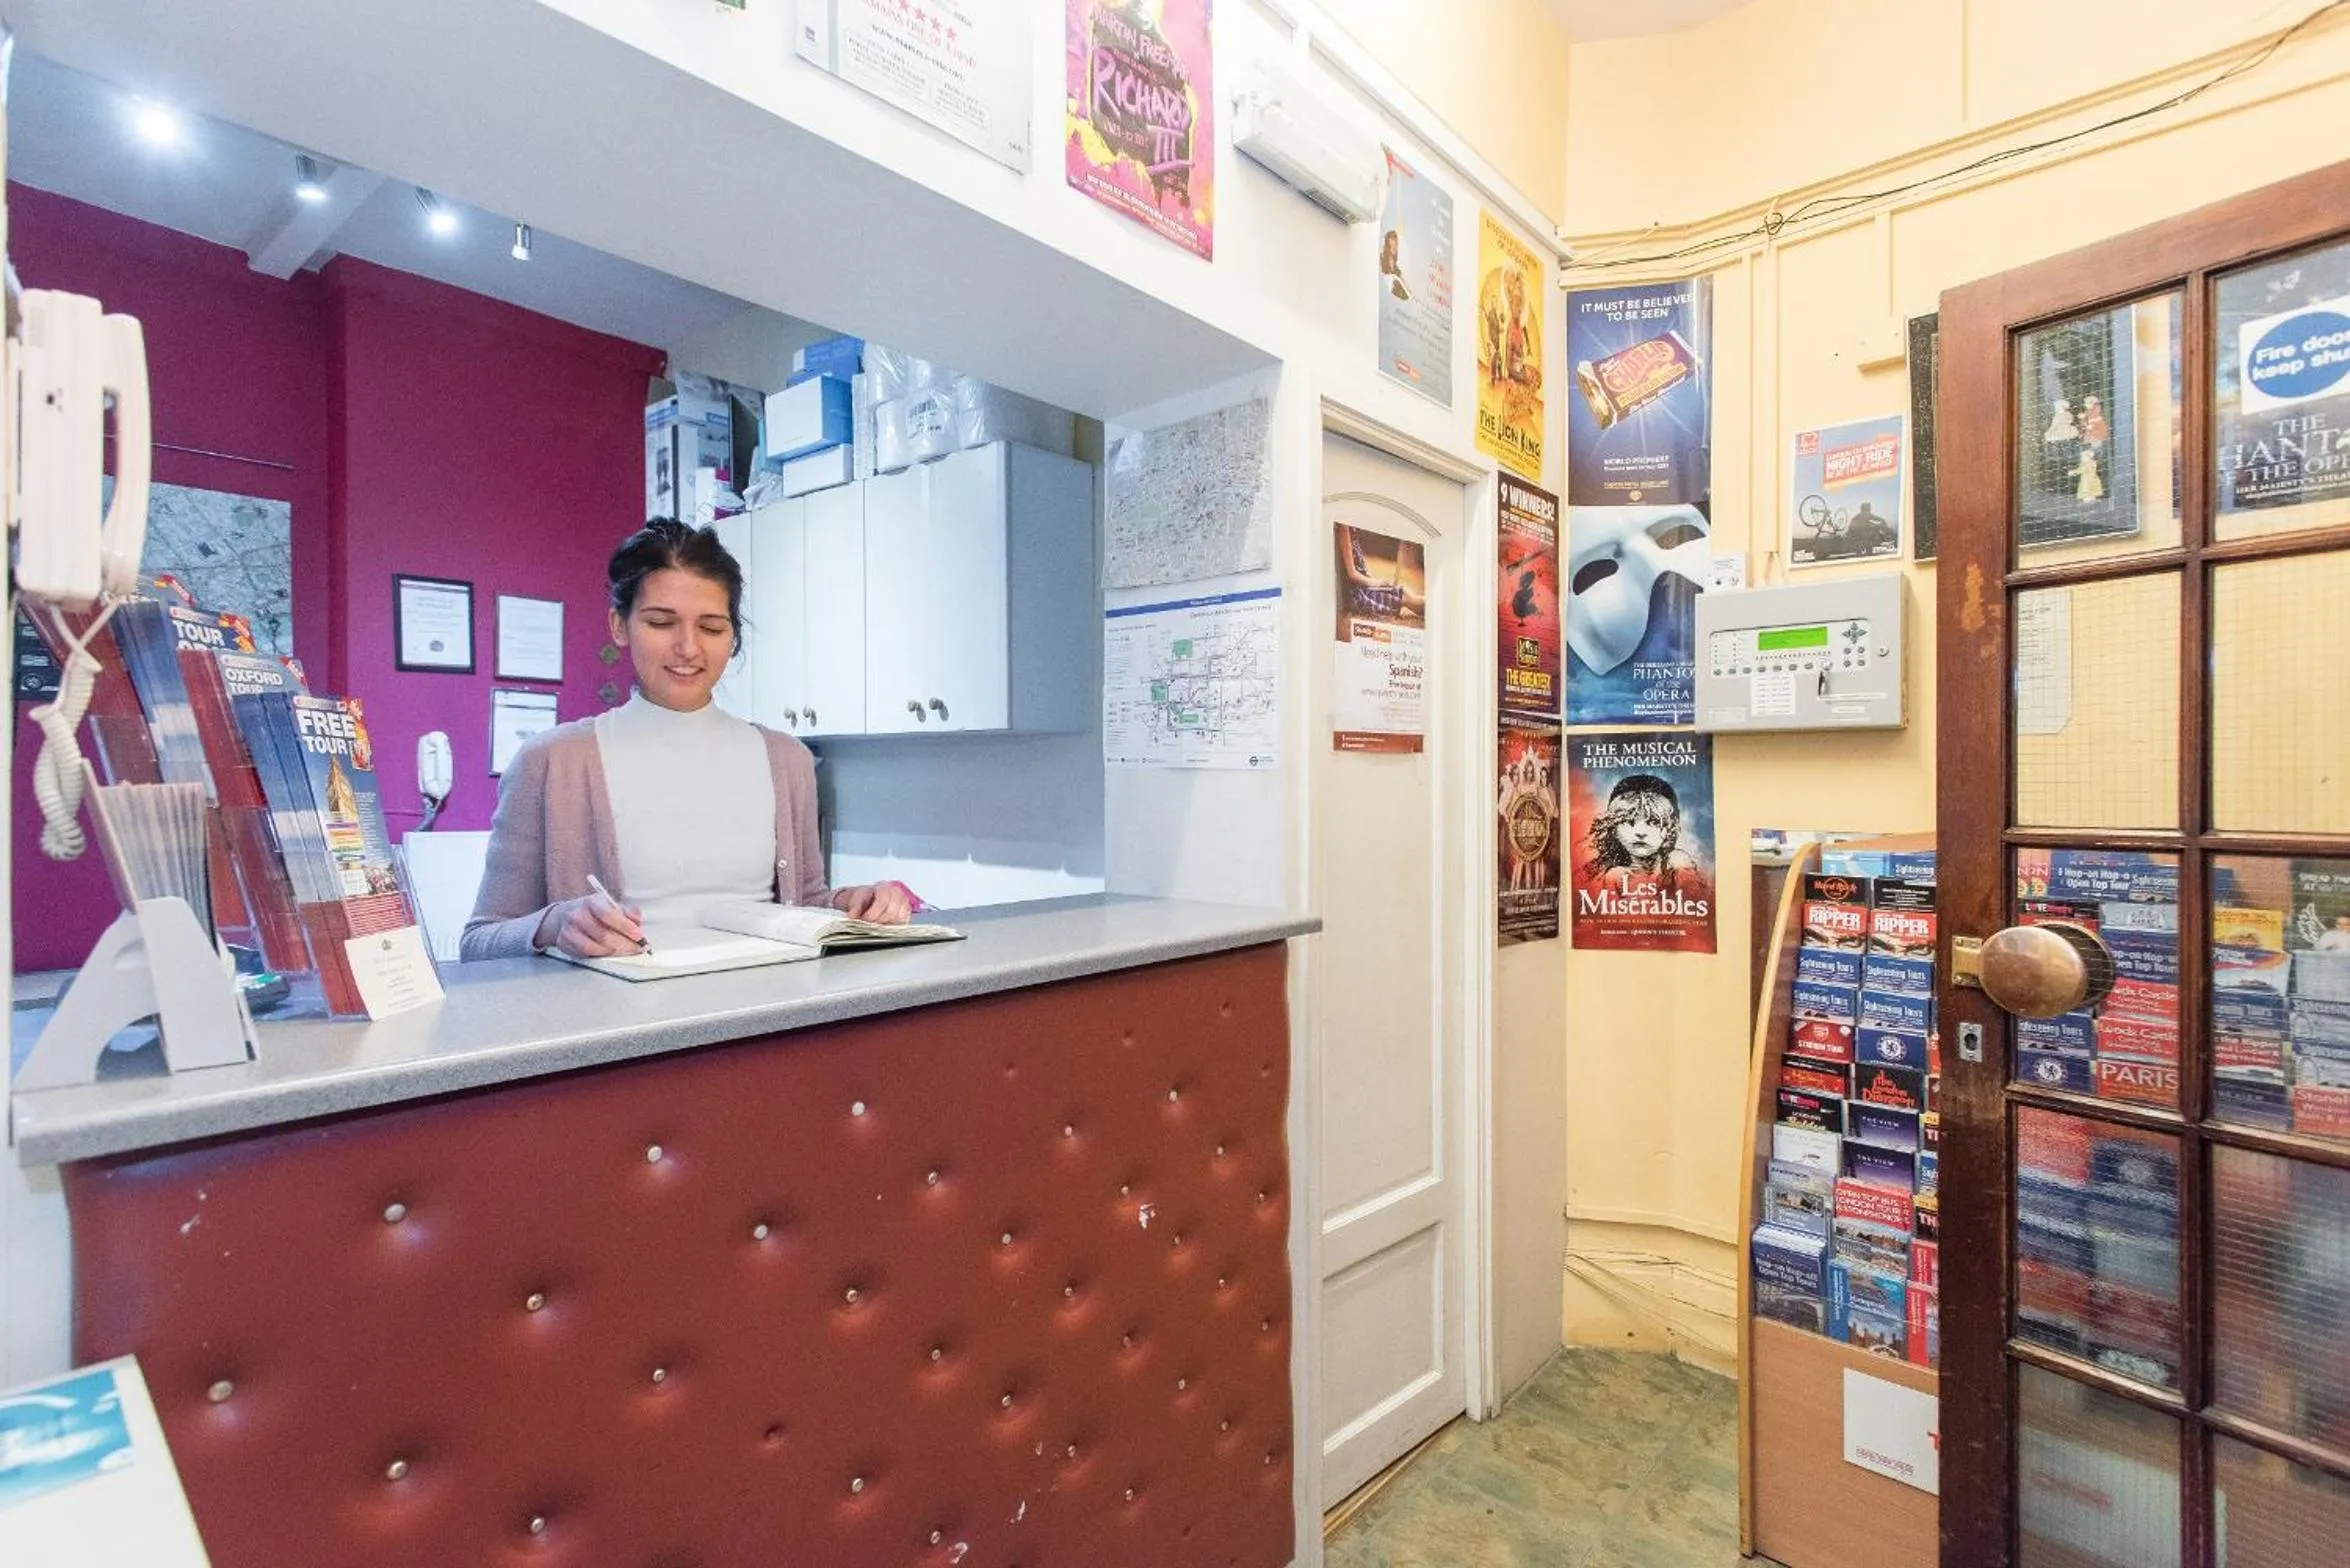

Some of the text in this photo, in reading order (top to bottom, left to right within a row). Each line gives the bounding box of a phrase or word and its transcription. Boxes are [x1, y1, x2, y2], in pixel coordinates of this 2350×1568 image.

[1093, 40, 1191, 130] RICHARD
[1581, 303, 1593, 313] IT
[1594, 301, 1625, 313] MUST
[1627, 299, 1641, 310] BE
[1606, 308, 1668, 322] TO BE SEEN
[2255, 344, 2296, 364] Fire
[2252, 348, 2350, 381] keep shu
[2272, 413, 2327, 436] THE
[1480, 409, 1496, 431] THE
[1498, 414, 1519, 444] LION
[1520, 427, 1541, 457] KING
[1827, 454, 1863, 470] NIGHT
[1866, 447, 1893, 463] RIDE
[2245, 461, 2298, 481] THE
[1500, 482, 1555, 521] 9 WINNERS!
[172, 620, 225, 646] TOUR
[225, 668, 283, 686] OXFORD
[1388, 663, 1424, 679] Spanish?
[1633, 667, 1695, 680] PHANTO
[227, 683, 264, 695] TOUR
[1642, 688, 1690, 701] OPERA
[294, 709, 357, 739] FREE
[302, 736, 348, 755] TOUR
[1583, 741, 1697, 756] THE MUSICAL
[1583, 754, 1697, 768] PHENOMENON
[2100, 869, 2130, 881] Hop-o
[1621, 874, 1657, 896] Les
[2066, 878, 2090, 889] Open
[2092, 879, 2107, 890] Top
[1578, 888, 1709, 917] Misérables
[1808, 907, 1861, 930] RIPPER
[1874, 917, 1928, 934] RIPPER
[2117, 950, 2142, 961] op-on
[1836, 960, 1854, 972] Tours
[1867, 965, 1926, 981] Sightseeing Tours
[2135, 961, 2151, 972] Top
[1831, 994, 1848, 1006] Tours
[1904, 1006, 1923, 1018] Tours
[2061, 1024, 2083, 1036] Tours
[1798, 1039, 1826, 1051] STADIUM
[2101, 1063, 2179, 1090] PARIS
[1863, 1193, 1879, 1202] TOP
[1918, 1212, 1936, 1227] TH
